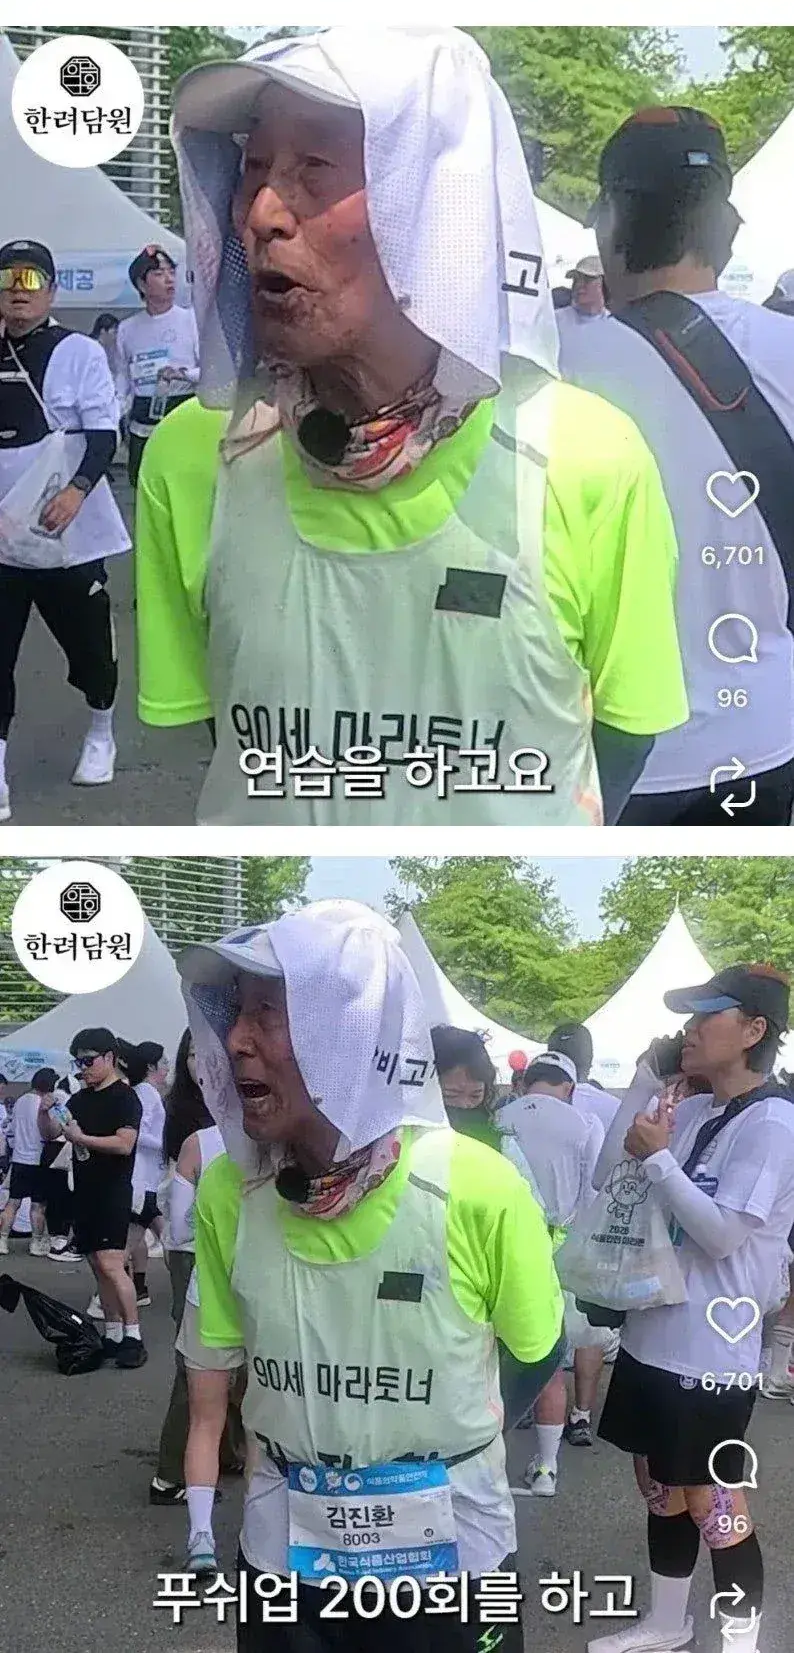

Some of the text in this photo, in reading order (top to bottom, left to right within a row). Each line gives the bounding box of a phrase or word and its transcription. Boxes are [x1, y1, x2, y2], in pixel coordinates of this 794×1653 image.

[253, 1356, 433, 1405] 90세 마라토너
[326, 1505, 395, 1529] 김진환
[343, 1532, 380, 1546] 8003
